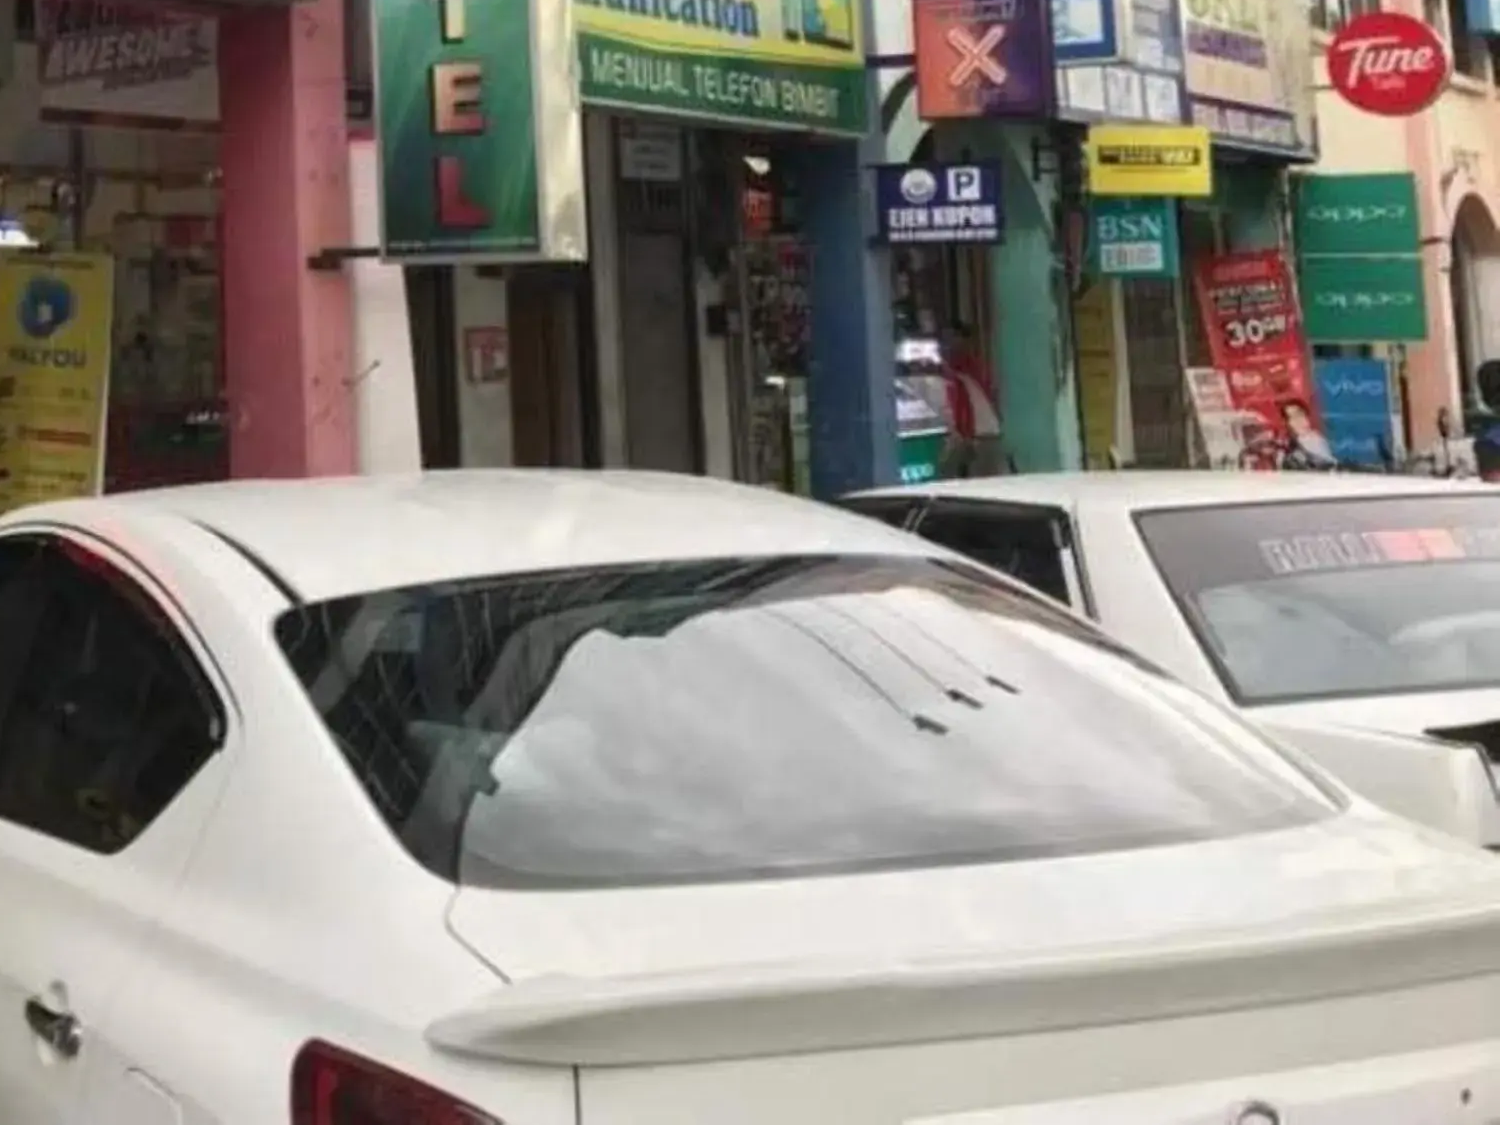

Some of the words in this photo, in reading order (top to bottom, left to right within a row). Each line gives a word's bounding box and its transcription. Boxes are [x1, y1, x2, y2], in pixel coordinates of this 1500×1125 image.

[45, 25, 197, 79] AWESOME
[589, 47, 690, 96] MENJUAL
[692, 65, 778, 108] TELEFON
[1338, 35, 1435, 90] Tune
[1097, 214, 1162, 240] BSN
